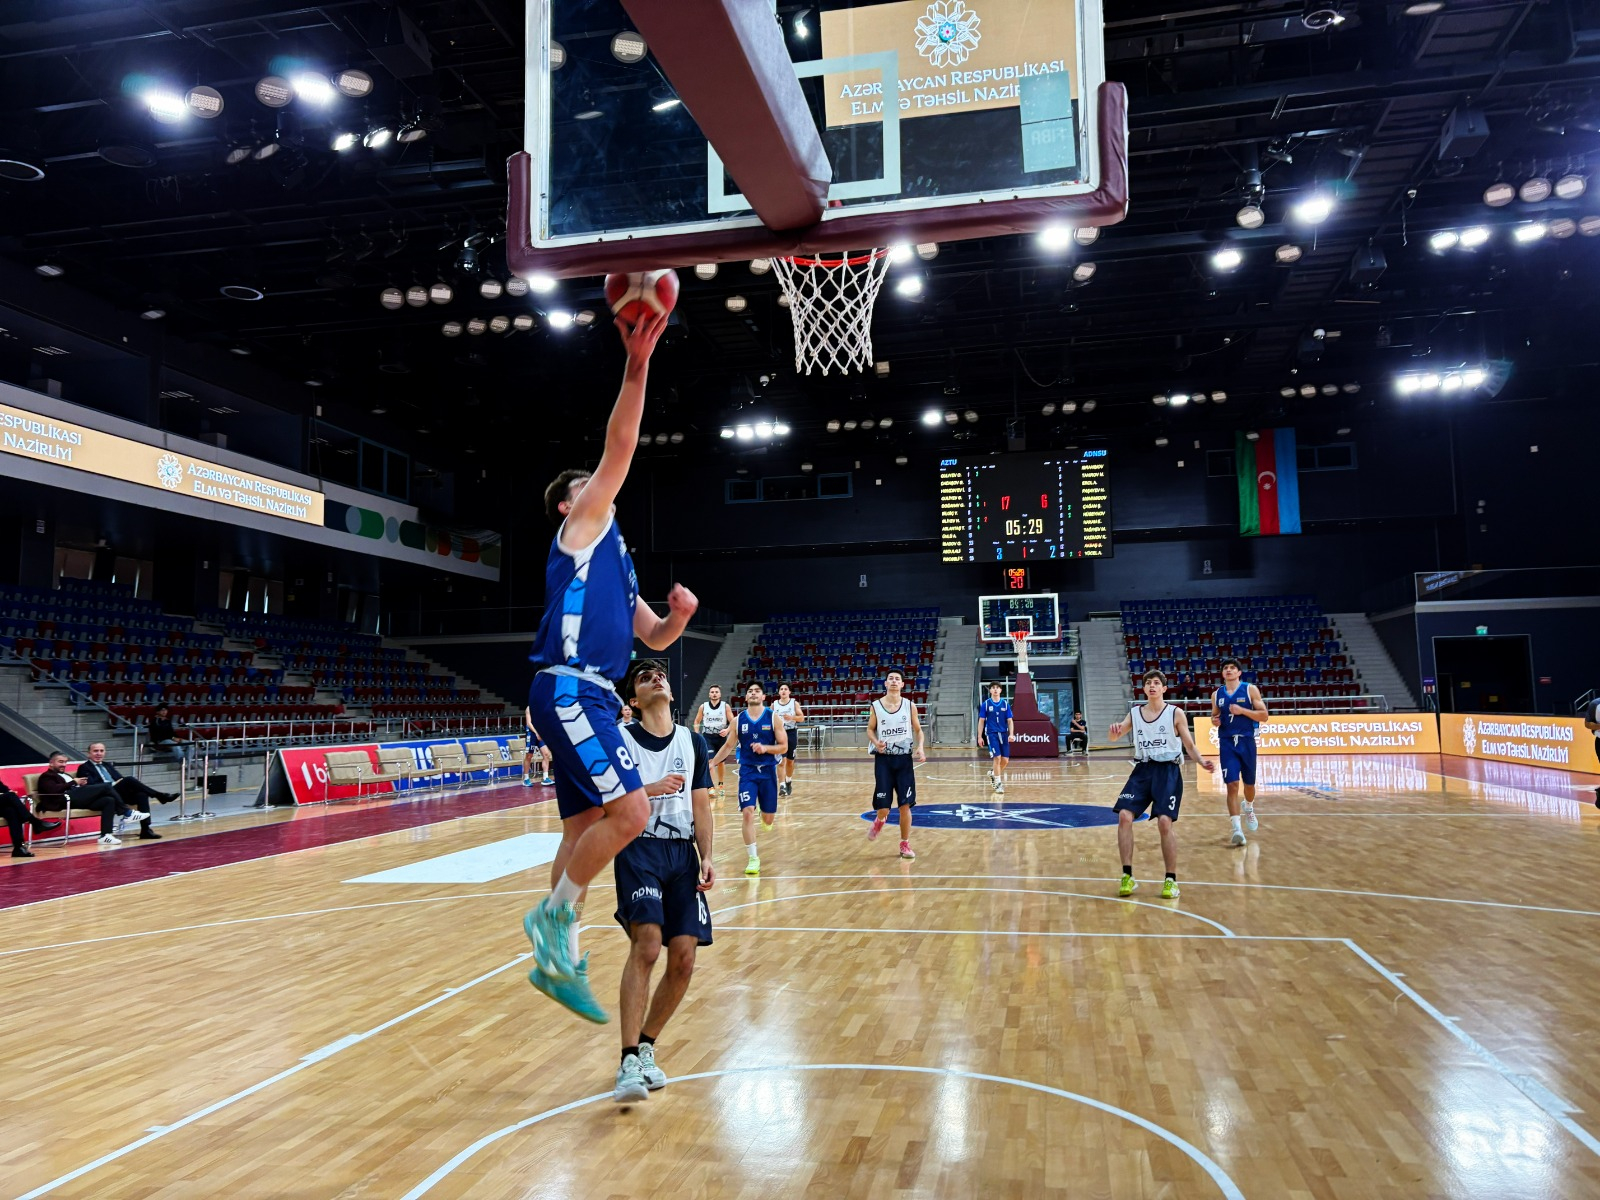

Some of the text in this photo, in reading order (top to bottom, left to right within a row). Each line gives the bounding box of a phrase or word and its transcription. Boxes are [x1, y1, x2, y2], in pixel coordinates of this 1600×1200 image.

[840, 74, 947, 98] AZƏRAYCAN
[913, 89, 970, 108] TƏHSİL
[0, 412, 82, 446] ESPUBLİKASI
[4, 432, 72, 461] NAZİRLİYİ
[187, 463, 312, 506] AZƏRBAYCAN RESPUBLİKASI
[194, 480, 217, 496] ELM
[233, 490, 264, 508] TƏHSİL
[266, 498, 306, 518] NAZİRLİYİ
[1002, 494, 1048, 510] 17 6
[1006, 518, 1043, 536] 05:29
[997, 545, 1056, 560] 3 1 2
[1010, 577, 1024, 589] 20
[1229, 714, 1234, 723] 7
[1258, 721, 1422, 734] ZƏRBAYCAN RESPUBLİKASI
[1478, 720, 1573, 741] AZƏRBAYCAN RESPUBLİKASI
[1301, 735, 1347, 747] TƏHSİL
[1350, 734, 1415, 746] NAZİRLİYİ
[616, 746, 634, 770] 8
[1482, 740, 1497, 754] ELM
[1506, 742, 1530, 759] TƏHSİL
[1532, 744, 1568, 764] NAZİRLİYİ
[740, 791, 751, 802] 15
[1168, 796, 1176, 810] 3
